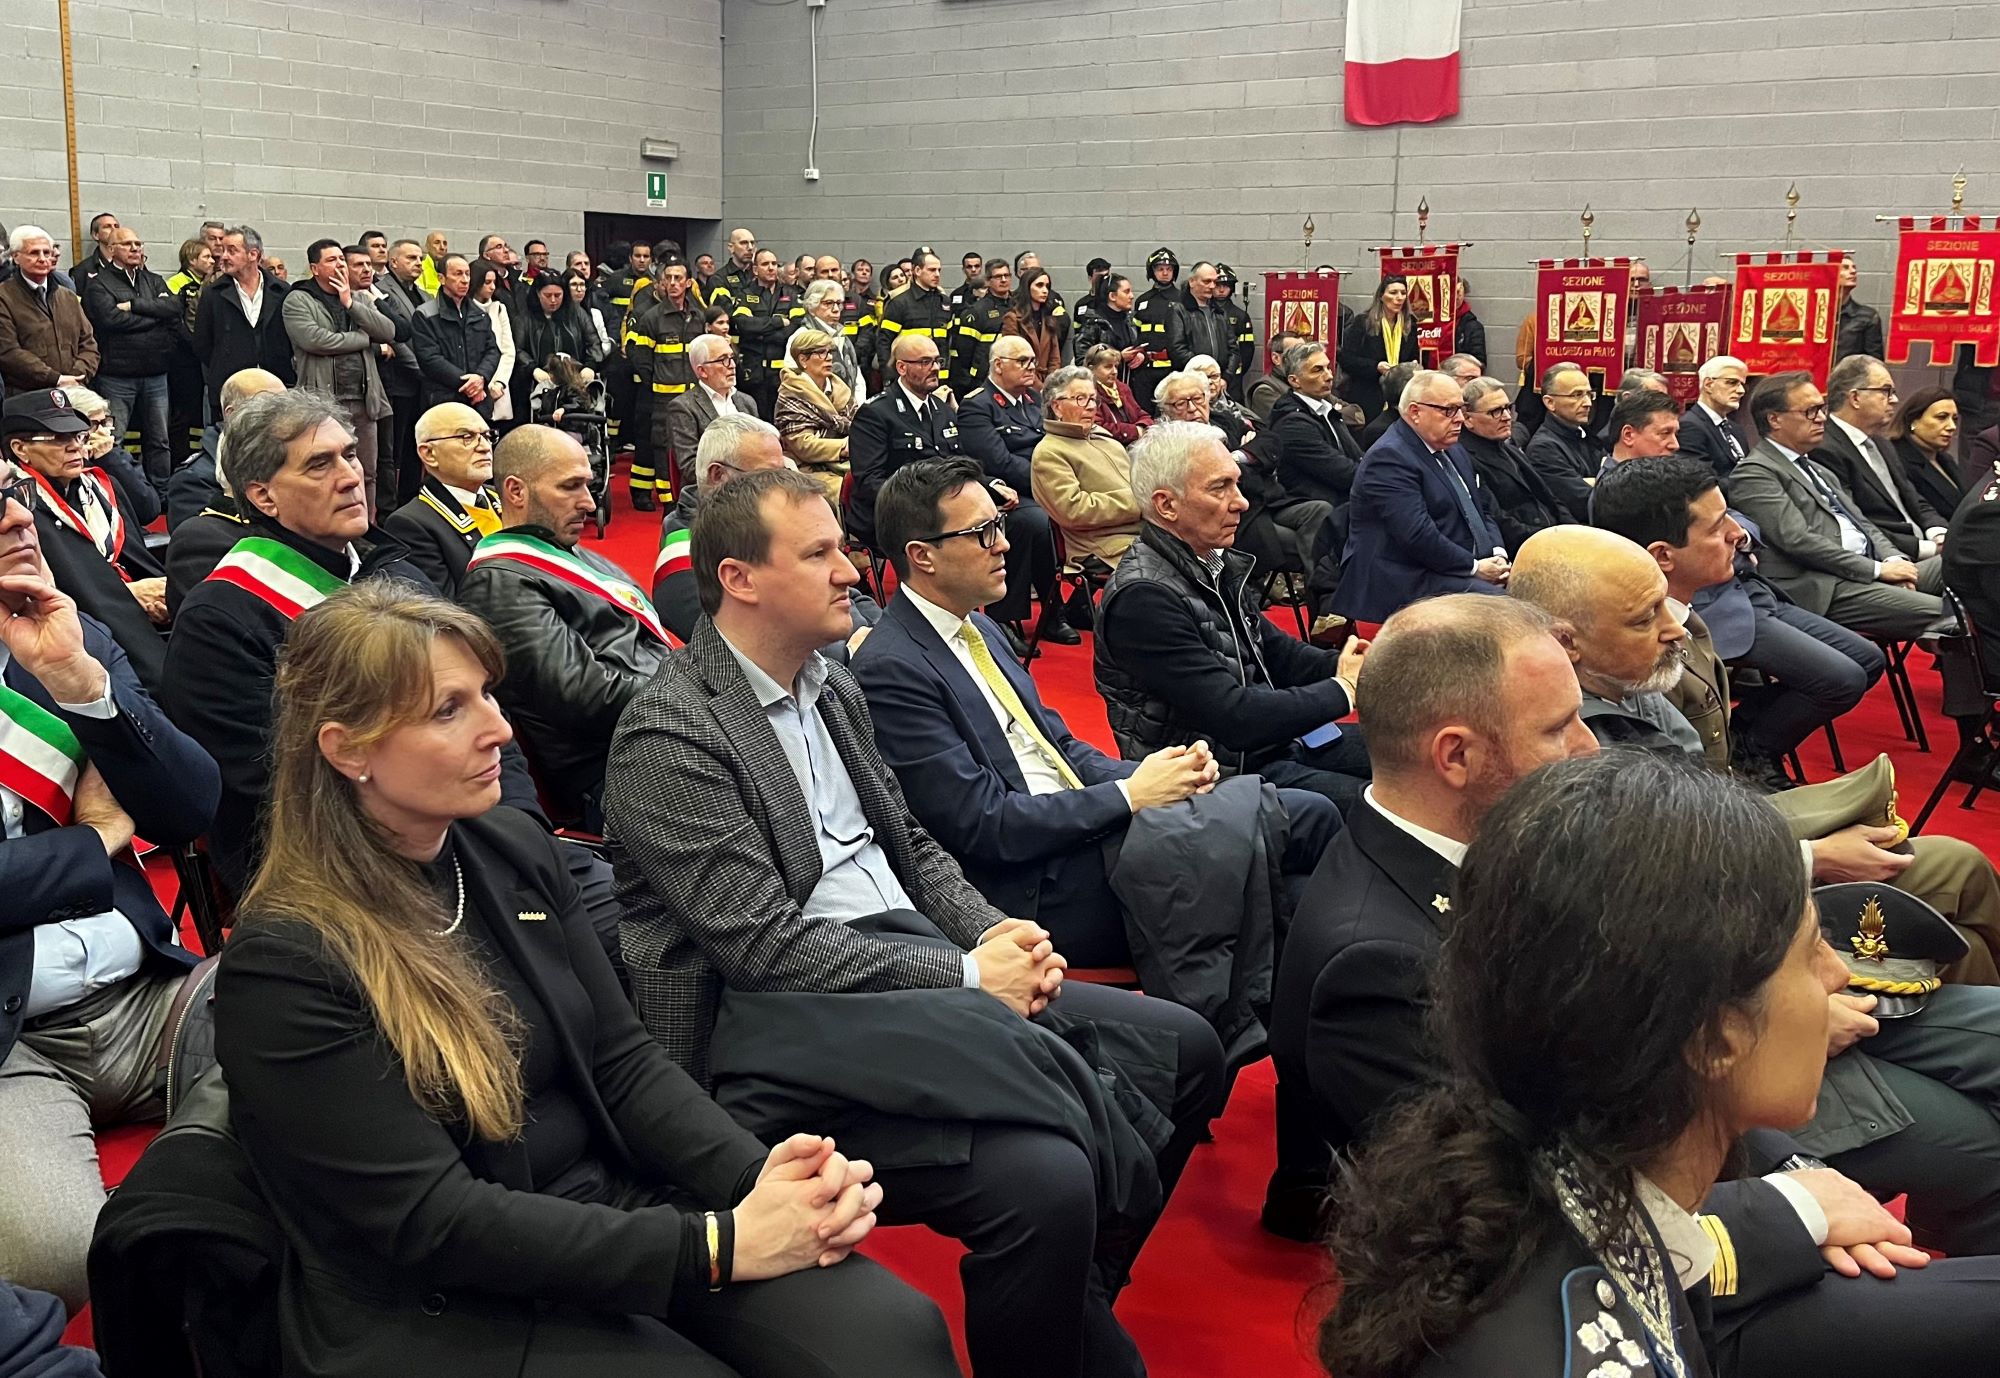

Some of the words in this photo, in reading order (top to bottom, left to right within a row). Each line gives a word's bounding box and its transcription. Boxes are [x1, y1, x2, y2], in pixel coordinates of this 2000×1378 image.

[1927, 240, 1980, 251] SEZIONE
[1401, 261, 1436, 271] SEZIONE
[1562, 276, 1606, 286] SEZIONE
[1763, 271, 1812, 282] SEZIONE
[1282, 289, 1319, 299] SEZIONE
